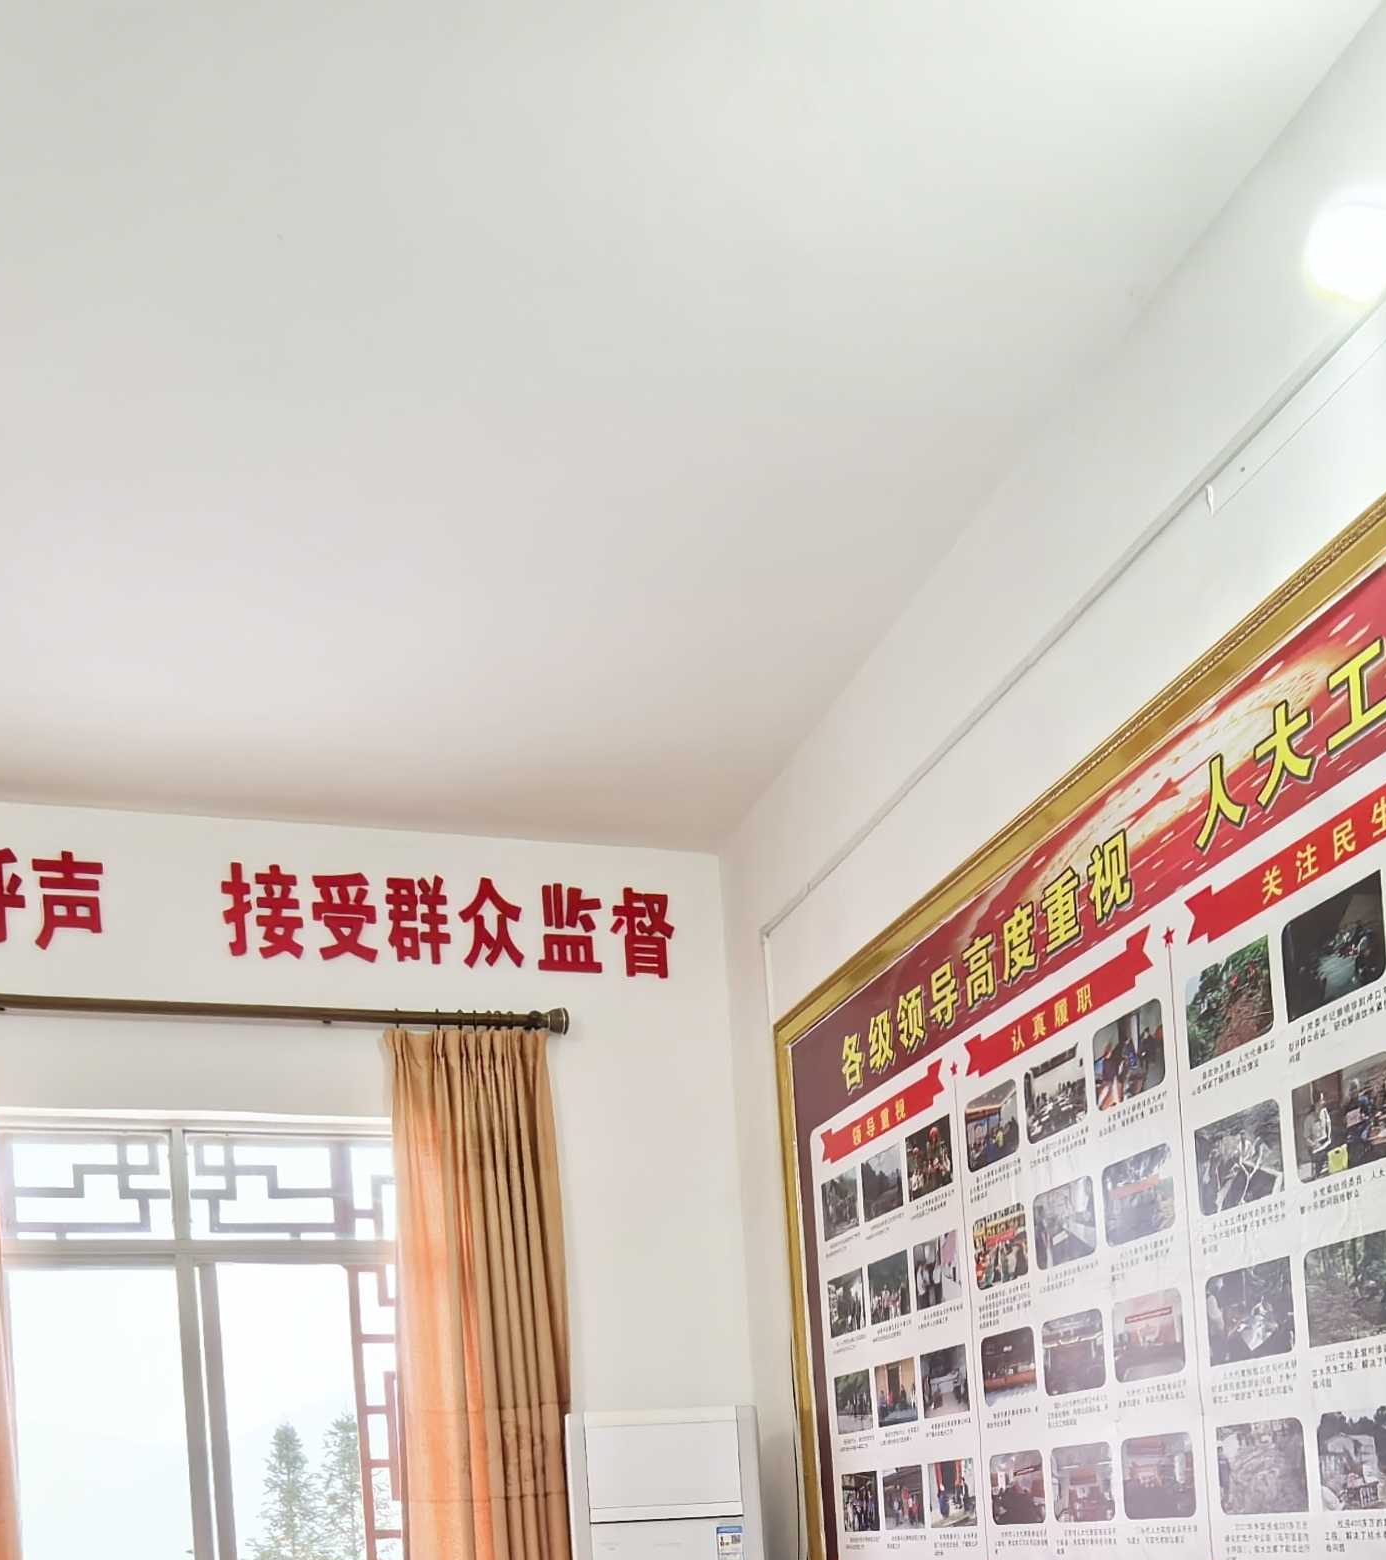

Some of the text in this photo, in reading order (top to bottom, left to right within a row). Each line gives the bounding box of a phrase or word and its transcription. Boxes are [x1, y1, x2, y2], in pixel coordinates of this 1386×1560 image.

[221, 862, 676, 979] 接受群众监督
[841, 829, 1132, 1091] 各级领导高度重视
[1011, 983, 1093, 1053] 认真履职
[852, 1097, 906, 1147] 领导重视
